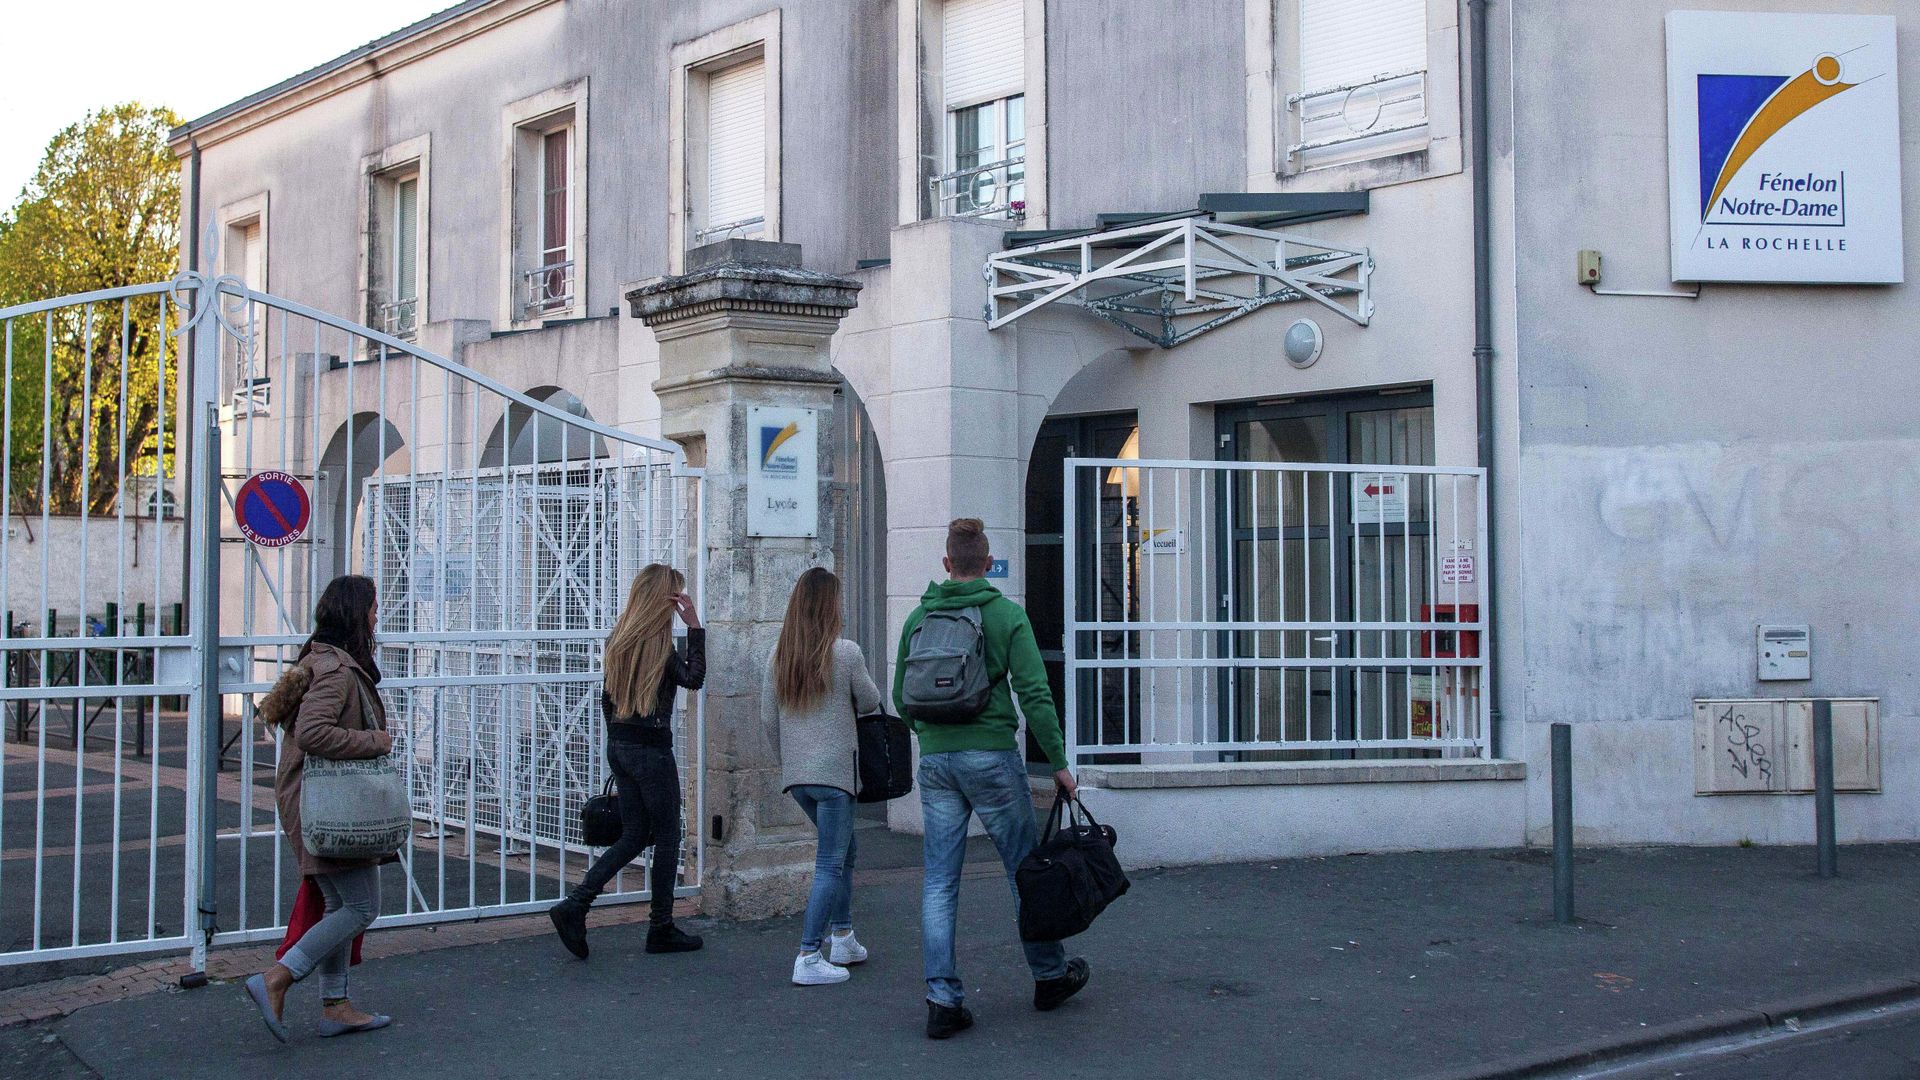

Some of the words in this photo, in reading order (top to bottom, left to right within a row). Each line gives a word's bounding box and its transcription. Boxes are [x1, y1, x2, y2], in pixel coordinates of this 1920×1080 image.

[1759, 172, 1837, 192] Fénelon
[1720, 197, 1838, 217] Notre-Dame
[1707, 237, 1729, 249] LA
[1742, 237, 1847, 251] ROCHELLE
[259, 472, 294, 485] SORTIE
[767, 497, 798, 512] Lycée
[241, 523, 254, 538] DE
[254, 528, 300, 546] VOITURES
